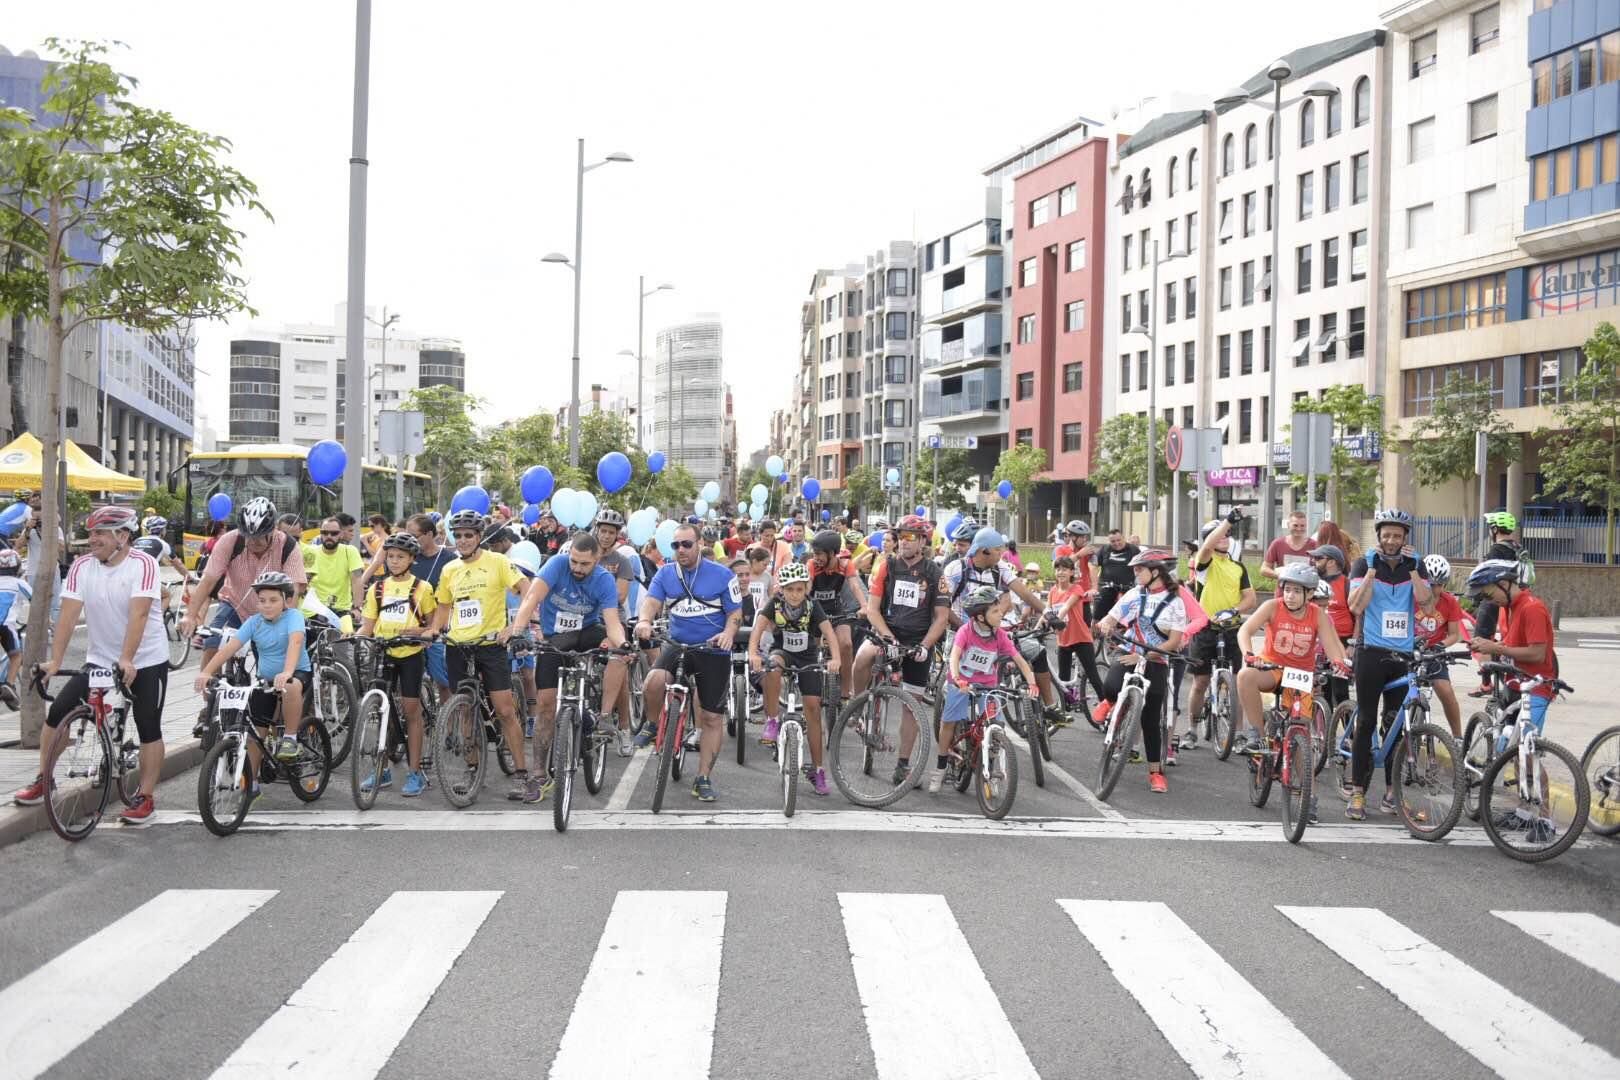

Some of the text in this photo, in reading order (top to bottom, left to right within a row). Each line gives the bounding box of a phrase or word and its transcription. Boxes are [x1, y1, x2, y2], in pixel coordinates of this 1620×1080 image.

[897, 588, 916, 599] 3154
[460, 608, 479, 619] 1389
[560, 618, 579, 628] 1355
[1386, 619, 1406, 629] 1348
[1273, 629, 1312, 656] 05
[970, 653, 989, 664] 3155
[1287, 672, 1310, 683] 1349
[223, 689, 246, 701] 1651
